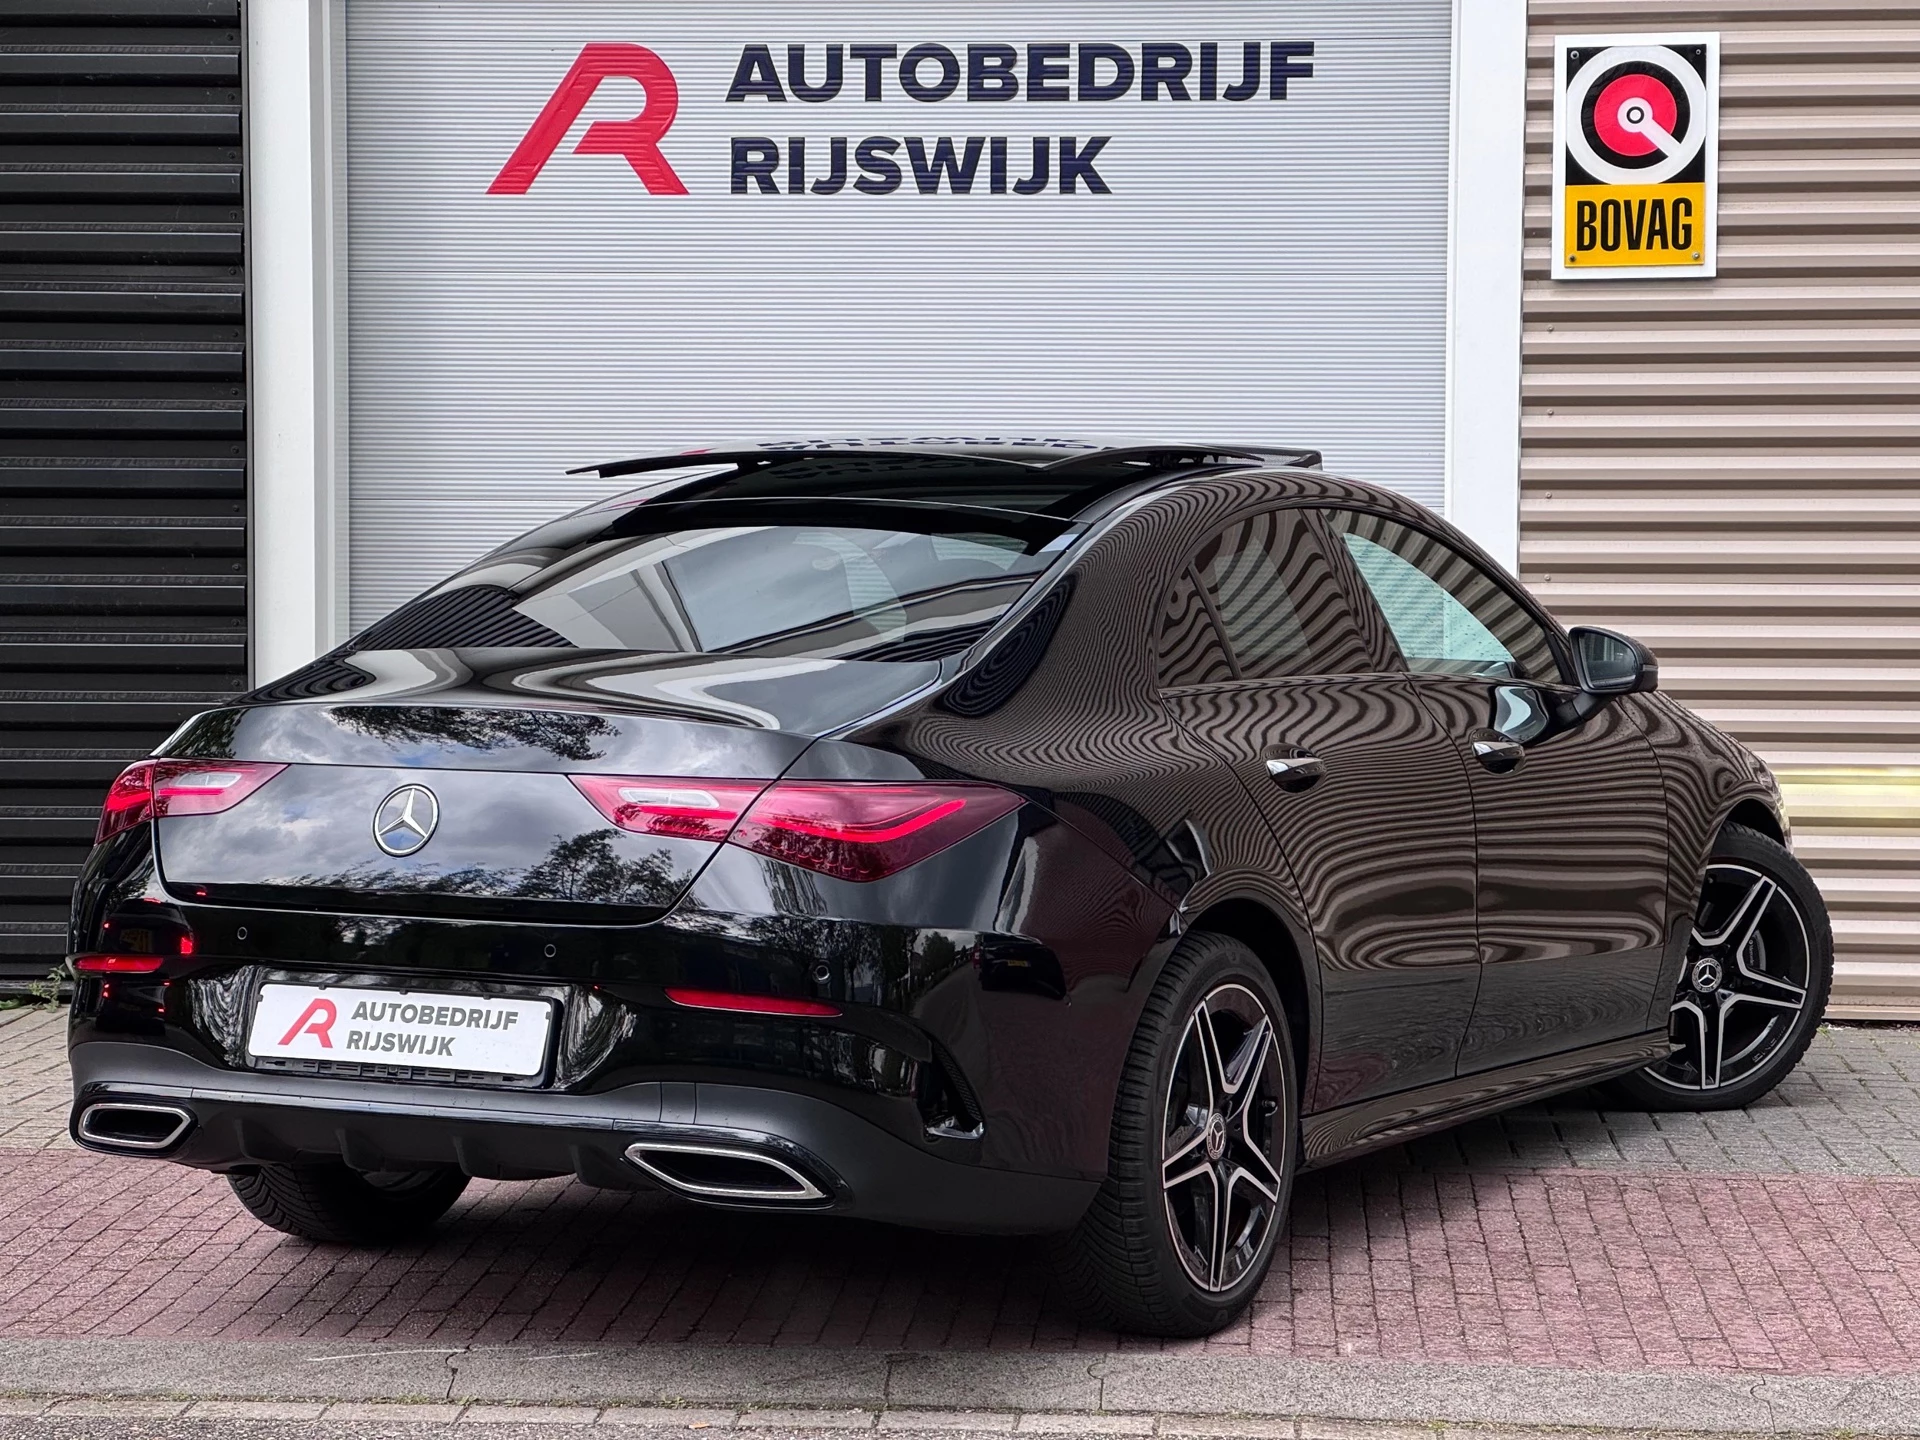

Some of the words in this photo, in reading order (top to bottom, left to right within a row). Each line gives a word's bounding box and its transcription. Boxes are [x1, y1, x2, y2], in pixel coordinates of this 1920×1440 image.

[725, 41, 1315, 103] AUTOBEDRIJF
[730, 136, 1113, 196] RIJSWIJK
[1576, 197, 1693, 252] BOVAG
[346, 1030, 456, 1057] RIJSWIJK
[351, 1001, 519, 1031] AUTOBEDRIJF
